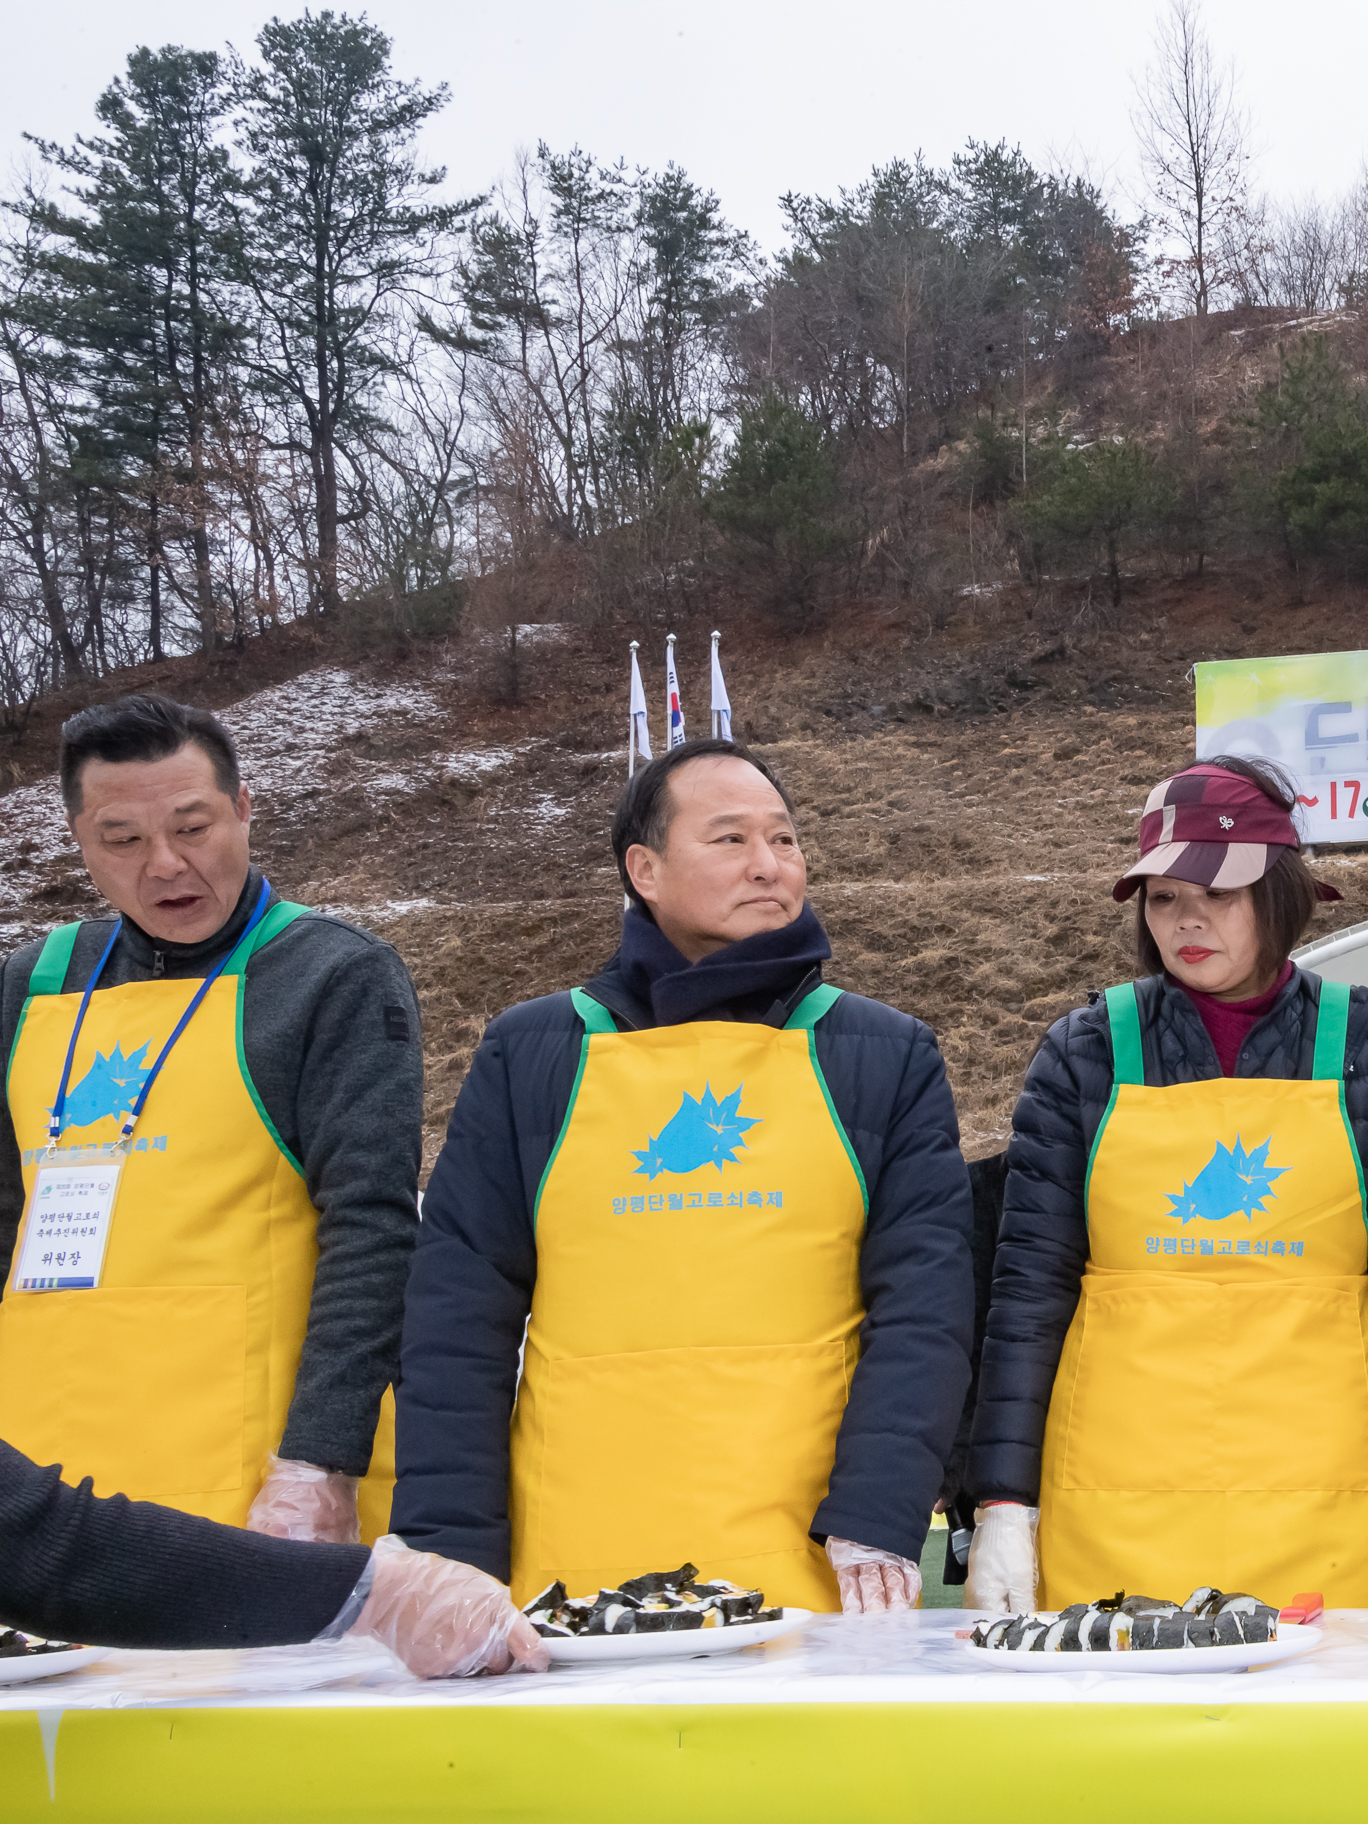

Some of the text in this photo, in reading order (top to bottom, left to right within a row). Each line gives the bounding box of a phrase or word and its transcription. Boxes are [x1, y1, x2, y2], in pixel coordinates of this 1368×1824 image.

[612, 1190, 783, 1215] 양평단월고로쇠축제
[40, 1211, 100, 1224] 양평단월고로쇠
[36, 1226, 97, 1238] 축제추진위원회
[1145, 1236, 1305, 1257] 양평단월고로쇠축제
[41, 1251, 82, 1267] 위원장
